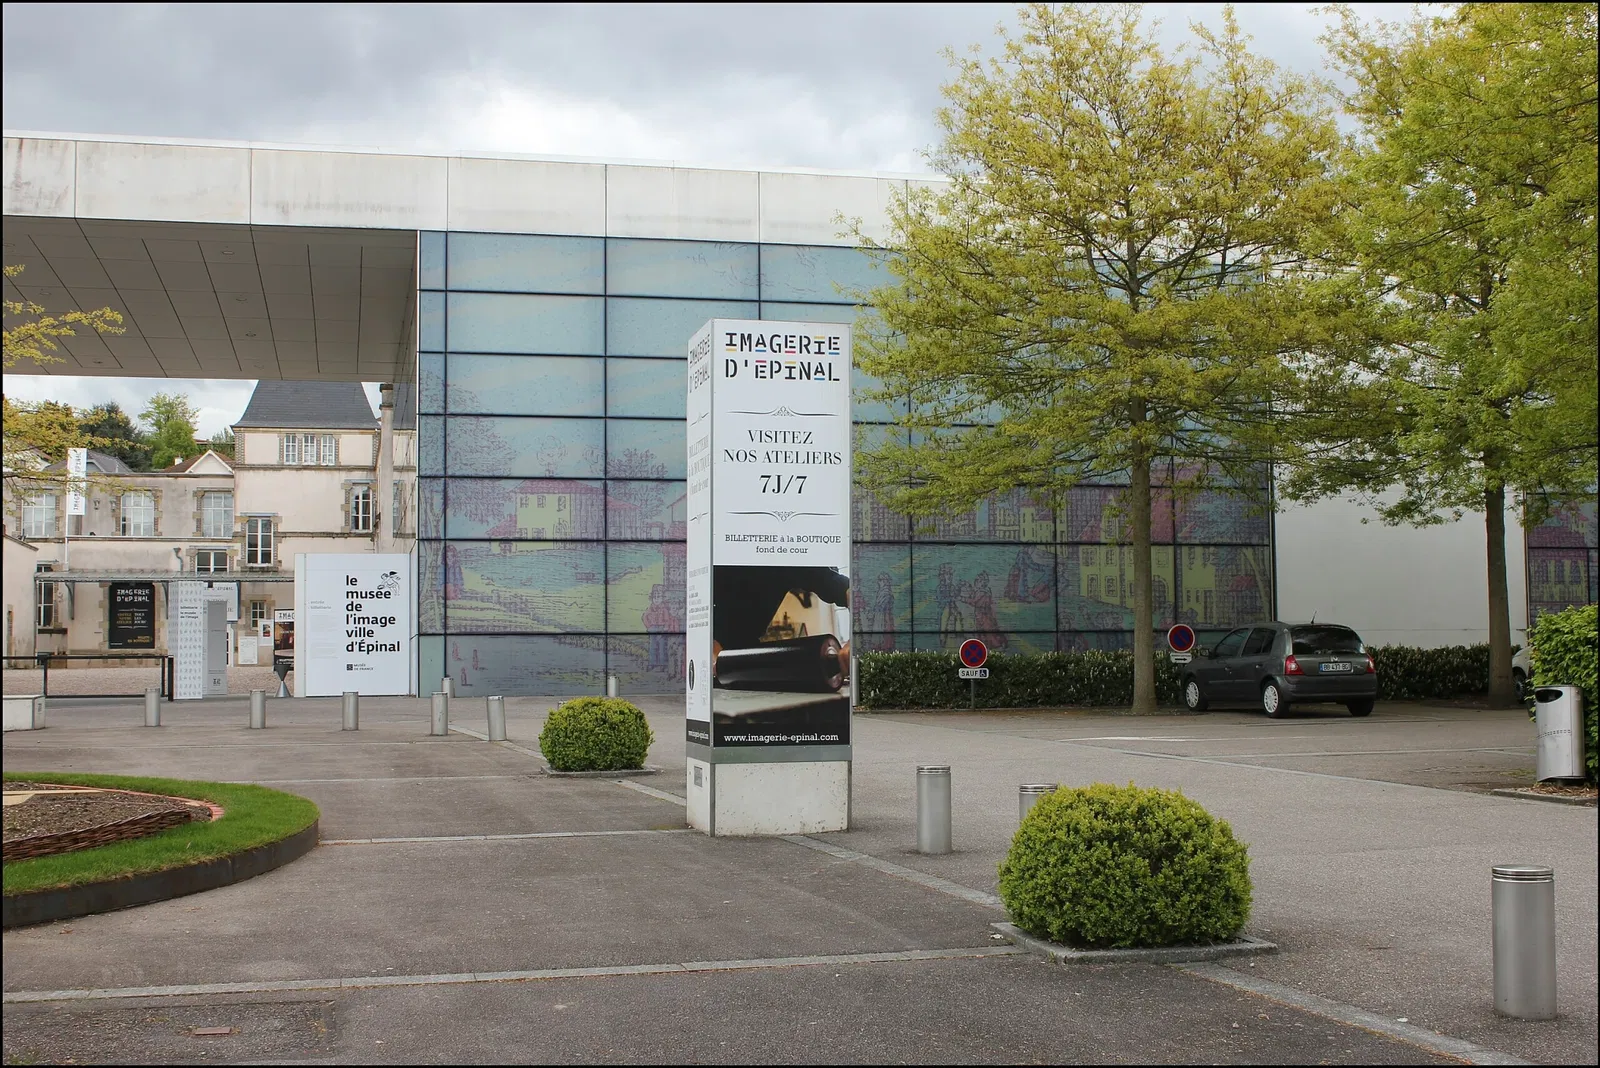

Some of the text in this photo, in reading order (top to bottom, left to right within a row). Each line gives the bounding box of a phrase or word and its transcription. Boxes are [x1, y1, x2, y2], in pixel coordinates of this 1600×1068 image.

[725, 332, 841, 356] IMAGERIE
[747, 430, 814, 445] VISITEZ
[723, 449, 842, 465] NOS ATELIERS
[759, 474, 809, 495] 7J/7
[725, 534, 841, 544] BILLETTERIE à la BOUTIQUE
[756, 545, 774, 554] fond
[777, 546, 788, 554] de
[345, 574, 358, 586] le
[345, 587, 392, 599] musée
[345, 600, 363, 612] de
[345, 613, 396, 628] l'image
[345, 626, 375, 638] ville
[345, 638, 401, 655] d'Épinal
[724, 732, 839, 743] www.imagerie-epinal.com
